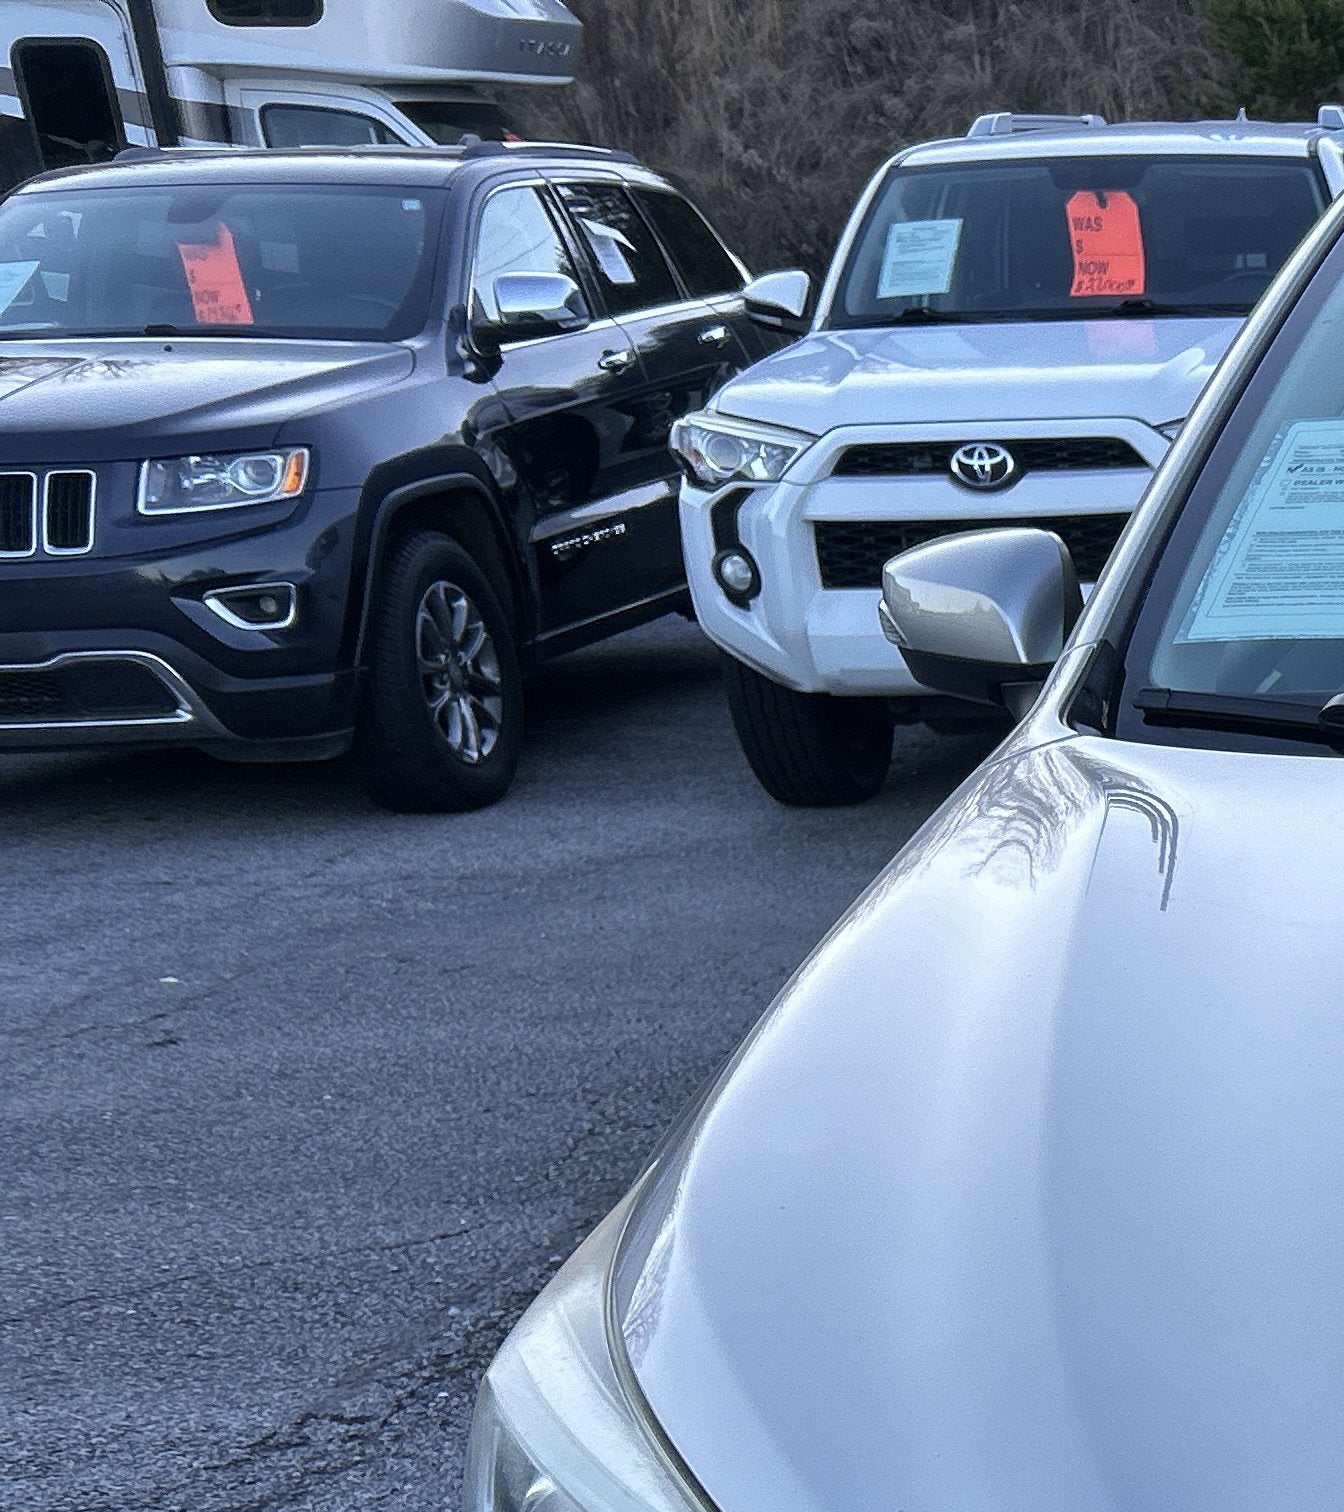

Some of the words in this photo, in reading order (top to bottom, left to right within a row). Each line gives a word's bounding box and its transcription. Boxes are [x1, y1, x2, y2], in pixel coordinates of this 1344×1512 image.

[1072, 216, 1103, 232] WAS
[1076, 239, 1084, 254] $
[1079, 261, 1109, 275] NOW
